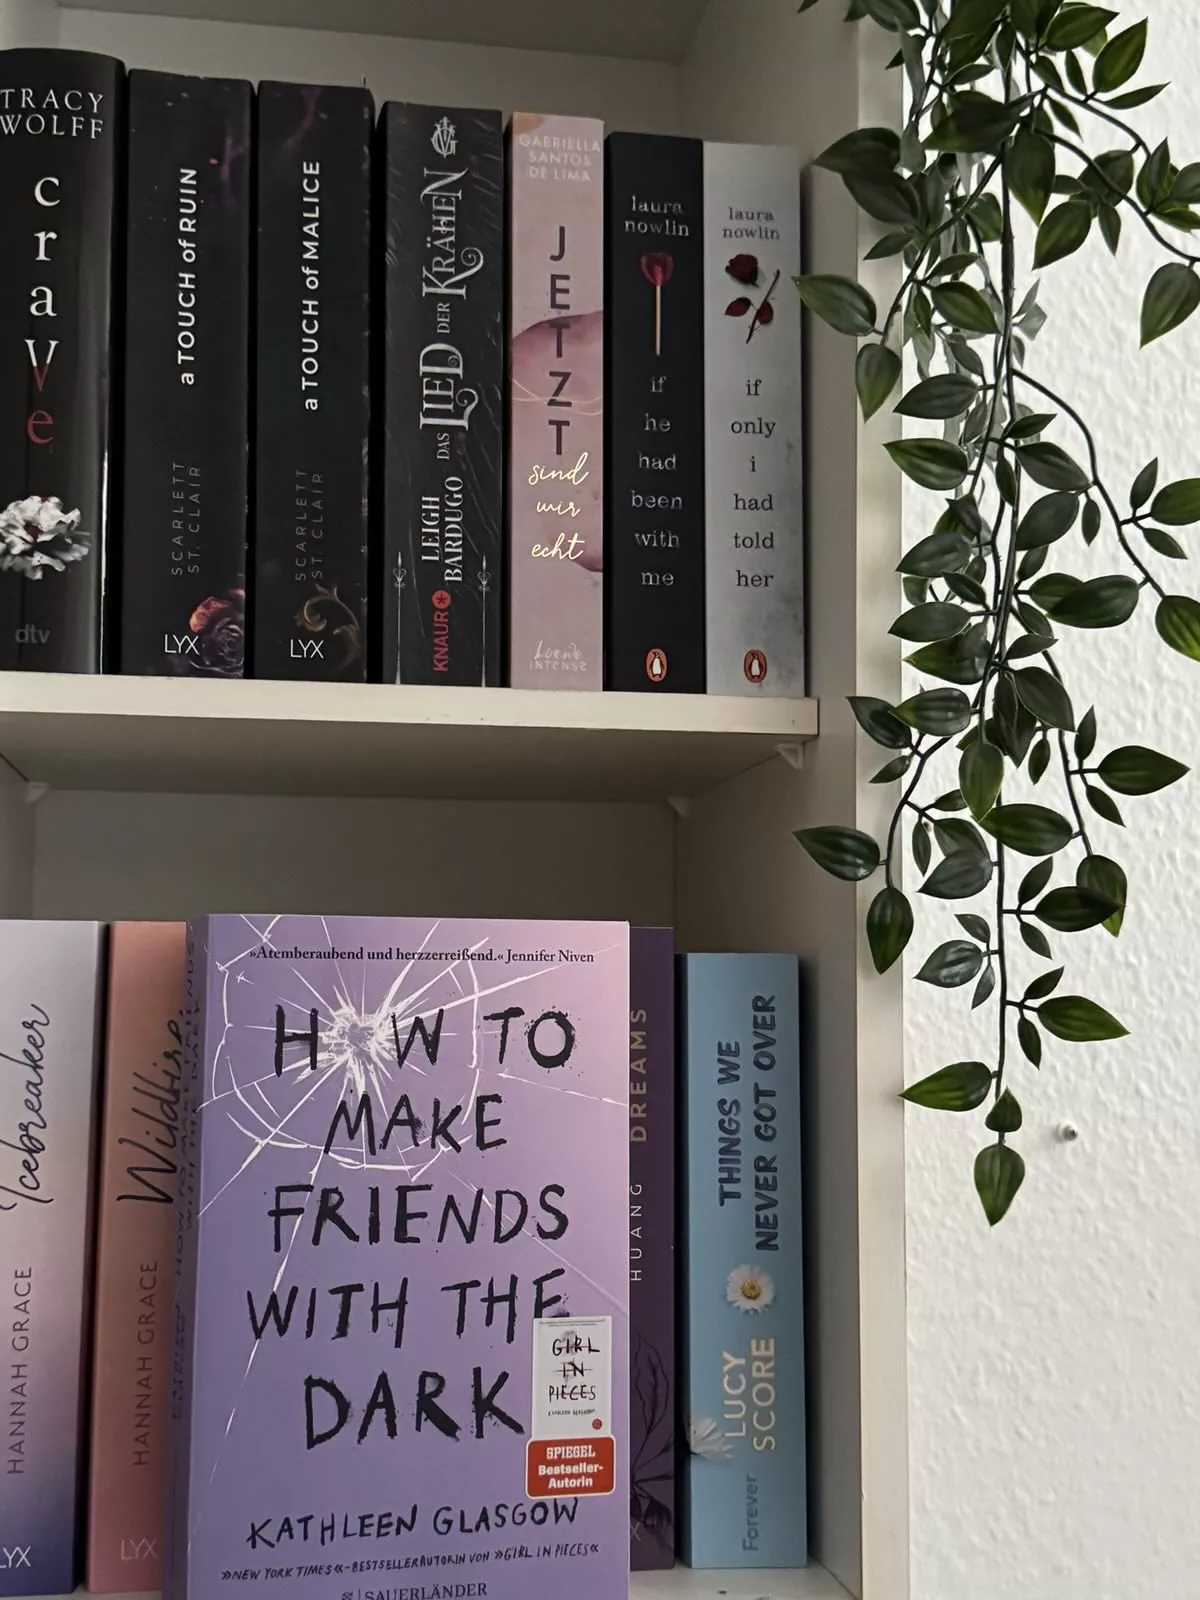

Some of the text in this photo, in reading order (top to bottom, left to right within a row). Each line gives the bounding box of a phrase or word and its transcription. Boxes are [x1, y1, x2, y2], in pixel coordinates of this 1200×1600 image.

[0, 88, 103, 113] TRACY
[0, 113, 103, 139] WOLFF
[518, 133, 601, 153] GABRIELLA
[527, 149, 592, 168] SANTOS
[528, 165, 592, 183] DE LIMA
[631, 195, 684, 215] laura
[728, 206, 775, 222] laura
[624, 218, 691, 238] nowlin
[722, 225, 781, 242] nowlin
[177, 168, 198, 386] a TOUCH of RUIN
[301, 161, 320, 411] a TOUCH of MALICE
[419, 167, 485, 461] DAS LIED DER KRÄHEN
[548, 225, 573, 456] JETZT
[650, 375, 667, 394] if
[744, 379, 763, 397] if
[643, 413, 672, 433] he
[730, 416, 777, 438] only
[528, 451, 589, 487] sind
[637, 451, 678, 472] had
[749, 456, 758, 473] i
[536, 500, 581, 518] wir
[631, 490, 684, 510] been
[733, 493, 774, 512] had
[171, 461, 186, 576] SCARLETT
[187, 466, 202, 573] ST. CLAIR
[295, 470, 308, 581] SCARLETT
[310, 472, 325, 580] ST. CLAIR
[421, 496, 441, 562] LEIGH
[444, 476, 464, 582] BARDUGO
[531, 532, 586, 562] echt
[633, 528, 681, 549] with
[733, 531, 775, 550] told
[640, 570, 675, 587] me
[735, 569, 774, 588] her
[15, 624, 51, 645] dtv
[163, 633, 200, 655] LYX
[432, 611, 450, 672] KNAUR
[289, 638, 325, 660] LYX
[367, 947, 394, 961] und
[504, 948, 556, 965] Jennifer
[558, 949, 595, 964] Niven
[483, 1005, 577, 1069] TO
[629, 1008, 648, 1142] DREAMS
[323, 1093, 508, 1157] MAKE
[716, 1039, 742, 1207] THINGS WE
[751, 994, 780, 1252] NEVER GOT OVER
[267, 1183, 570, 1253] FRIENDS
[629, 1183, 643, 1281] HUANG
[246, 1275, 409, 1349] WITH
[551, 1334, 601, 1358] GIRL
[6, 1266, 32, 1475] HANNAH GRACE
[132, 1261, 158, 1467] HANNAH GRACE
[561, 1361, 585, 1379] IN
[548, 1384, 597, 1403] PIECES
[721, 1349, 747, 1439] LUCY
[750, 1337, 776, 1451] SCORE
[303, 1366, 526, 1450] DARK
[545, 1444, 597, 1461] SPIEGEL
[537, 1461, 604, 1477] Bestseller-
[547, 1475, 594, 1490] Autorin
[245, 1503, 418, 1550] KATHLEEN
[432, 1496, 579, 1536] GLASGOW
[742, 1473, 759, 1551] Forever
[120, 1538, 157, 1561] LYX
[264, 1565, 294, 1581] YORK
[468, 1550, 491, 1565] VON
[536, 1543, 552, 1559] IN
[364, 1581, 488, 1600] SAUERLÄNDER
